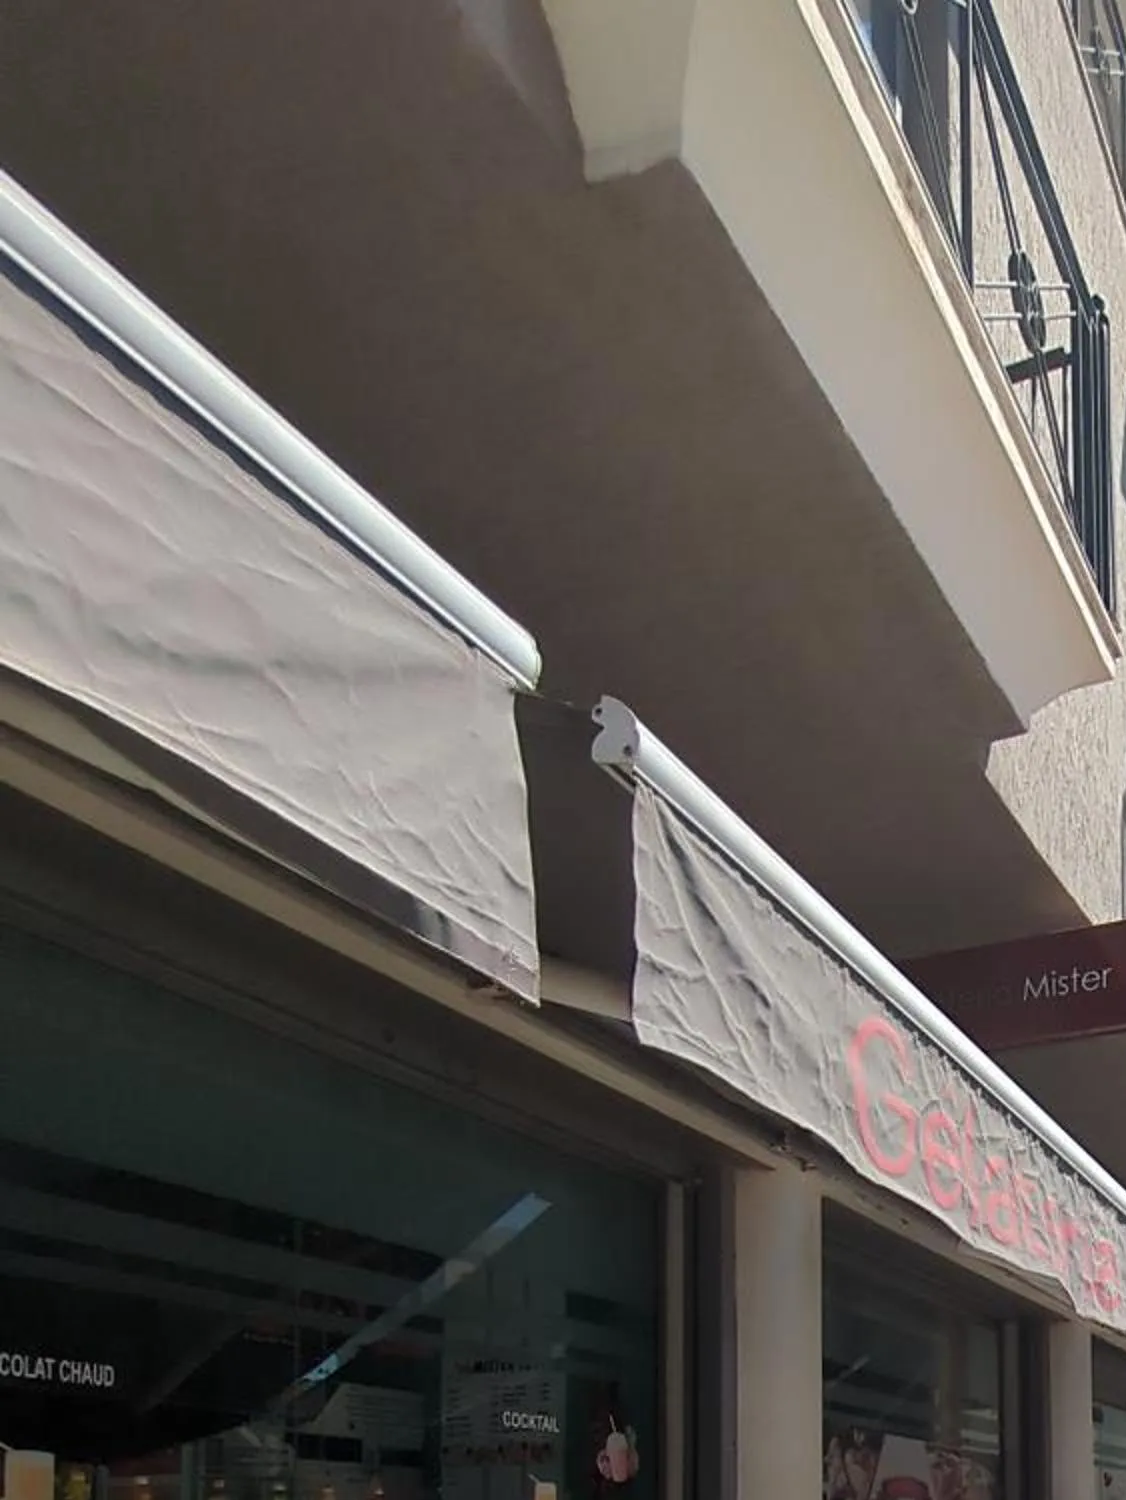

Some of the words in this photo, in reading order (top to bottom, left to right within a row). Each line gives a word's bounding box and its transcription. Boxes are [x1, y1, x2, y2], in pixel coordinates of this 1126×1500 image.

[1023, 966, 1113, 1001] Mister
[0, 1352, 56, 1380] COLAT
[59, 1359, 116, 1387] CHAUD
[502, 1410, 561, 1434] COCKTAIL
